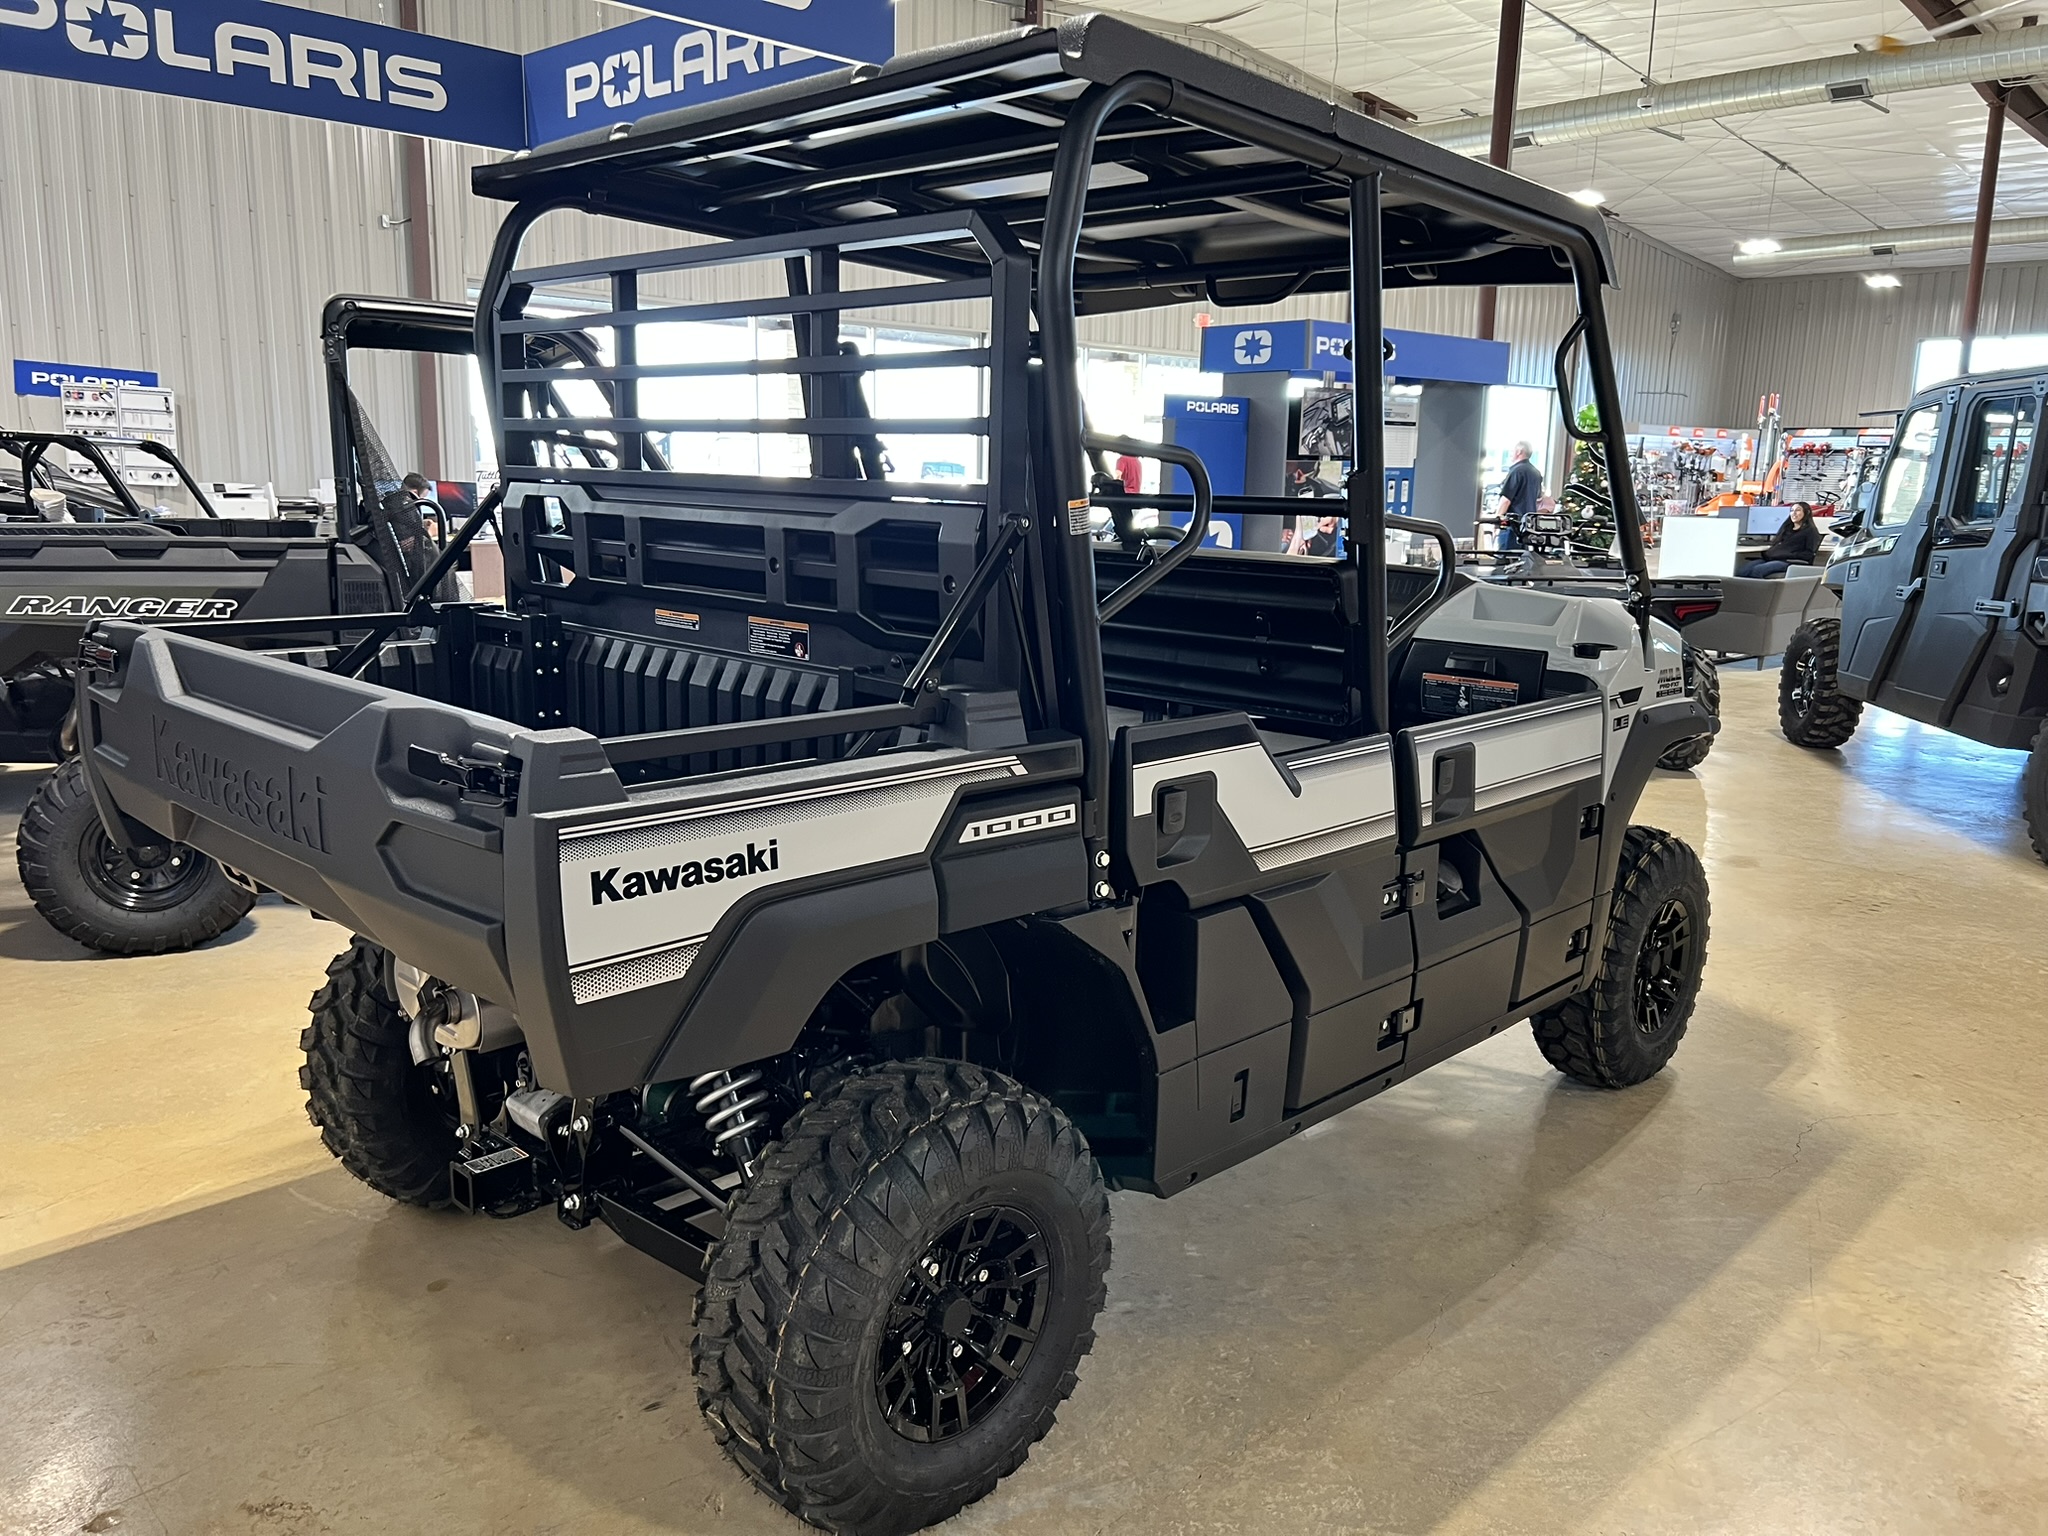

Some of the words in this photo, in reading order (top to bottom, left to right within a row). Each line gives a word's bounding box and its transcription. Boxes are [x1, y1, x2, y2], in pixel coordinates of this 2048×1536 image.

[1186, 401, 1239, 414] POLARIS
[5, 595, 238, 619] RANGER
[1613, 715, 1629, 731] LE
[153, 714, 332, 855] Kawasaki
[971, 809, 1071, 838] 1000
[590, 838, 779, 906] Kawasaki
